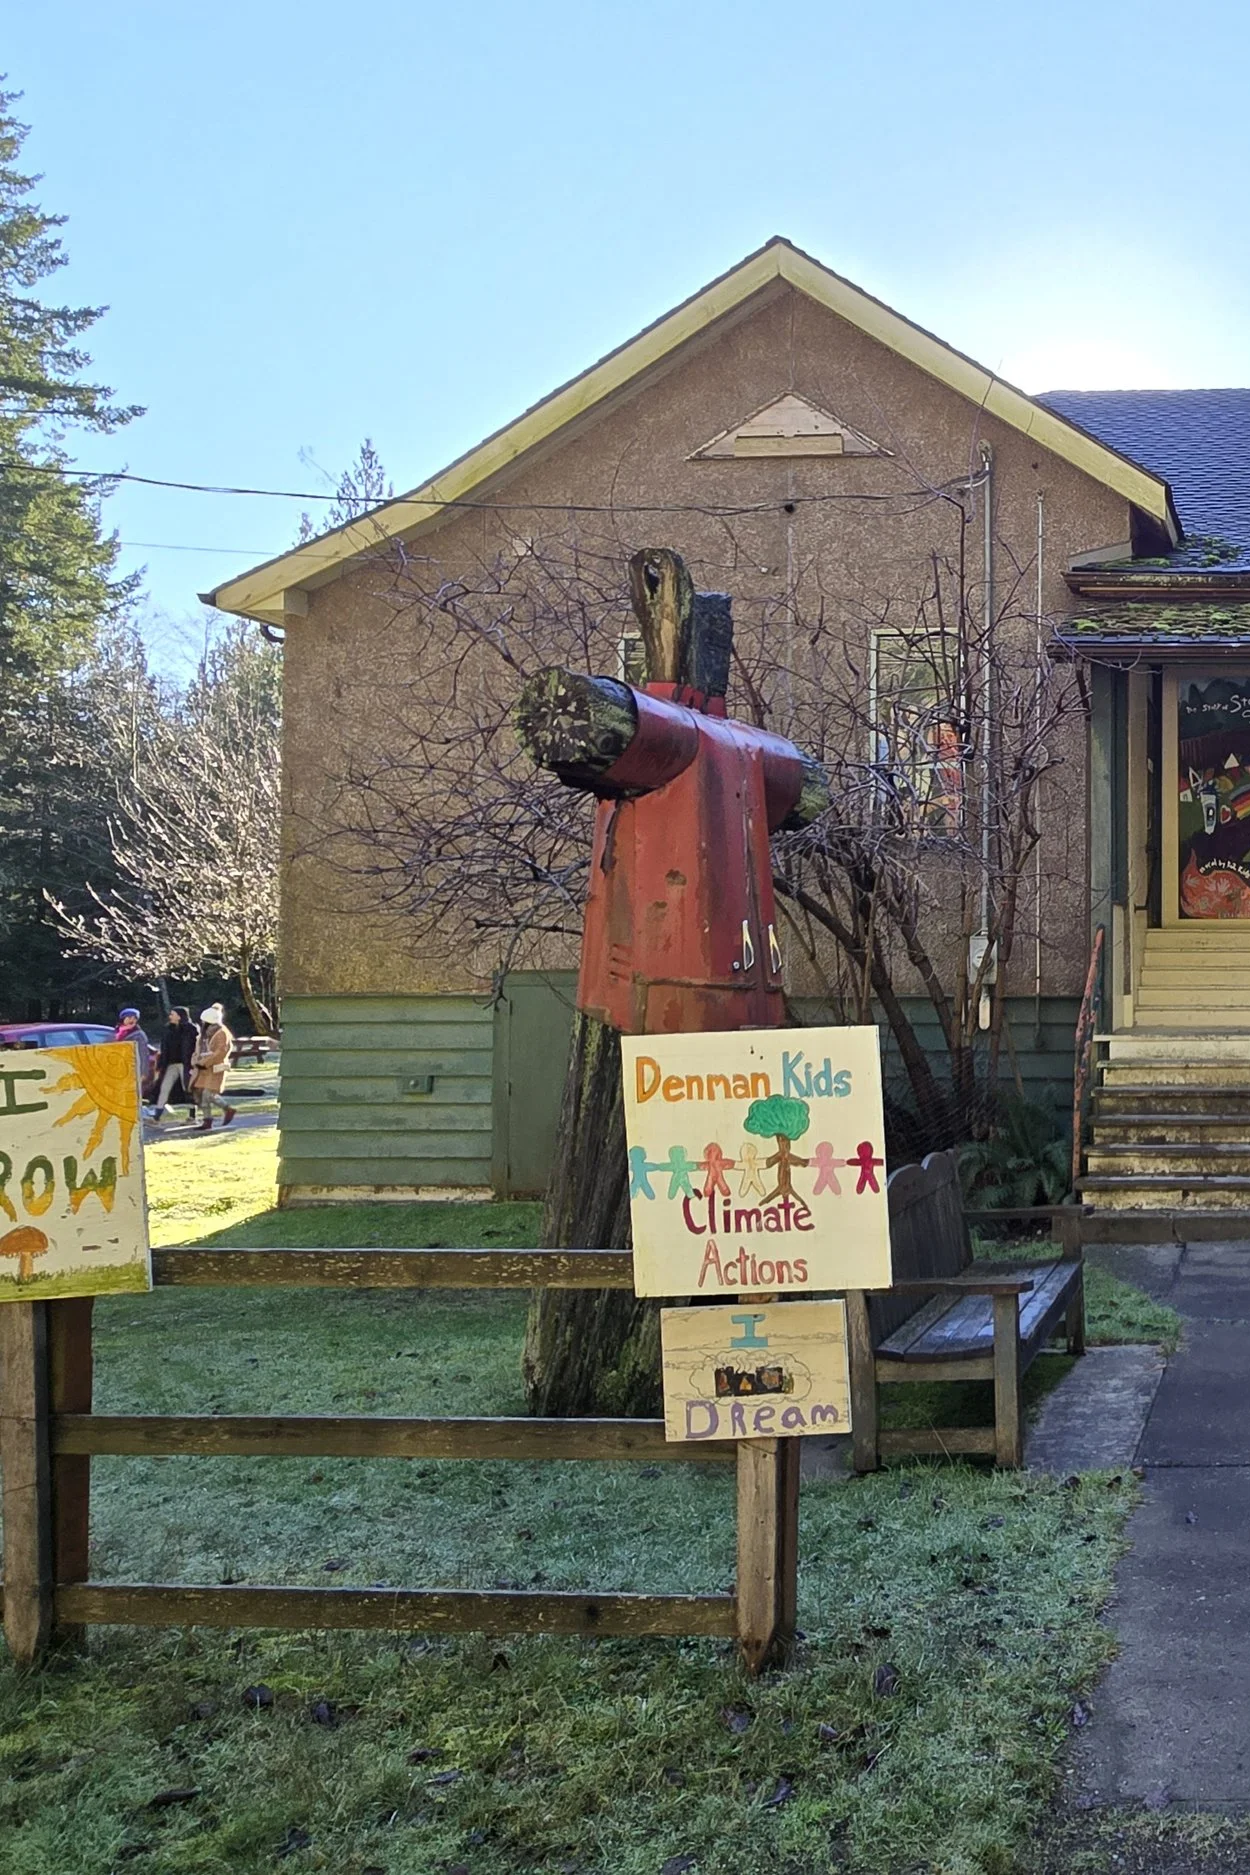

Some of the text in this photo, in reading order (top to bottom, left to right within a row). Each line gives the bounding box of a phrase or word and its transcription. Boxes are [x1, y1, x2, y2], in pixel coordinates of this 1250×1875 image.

[635, 1050, 853, 1104] Denman Kids
[682, 1188, 815, 1235] Climate
[697, 1238, 809, 1288] Actions
[730, 1313, 769, 1348] I
